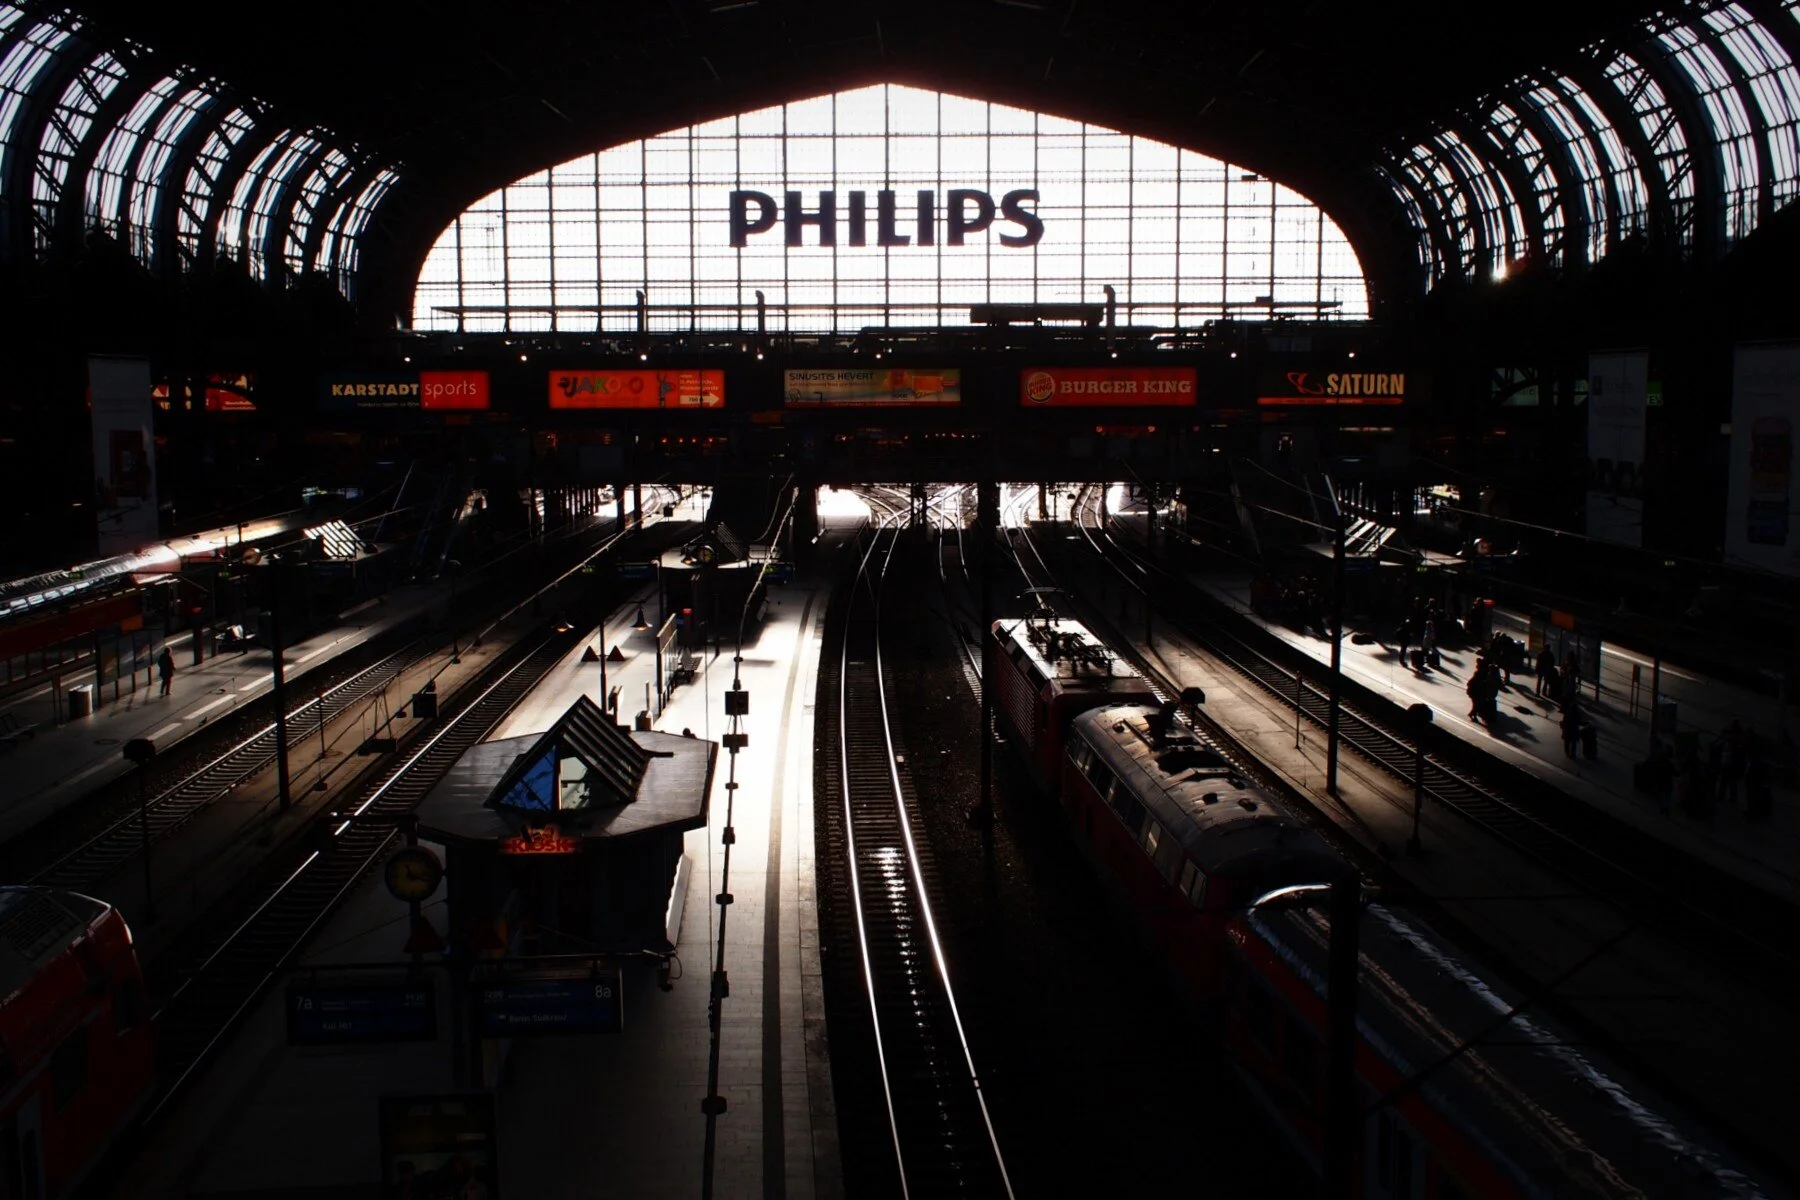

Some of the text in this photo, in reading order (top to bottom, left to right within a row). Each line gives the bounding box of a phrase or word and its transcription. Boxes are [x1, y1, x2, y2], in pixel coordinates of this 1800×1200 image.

[729, 189, 1045, 248] PHILIPS
[789, 372, 874, 381] SINUSITIS HEVERT
[1327, 373, 1405, 395] SATURN
[331, 383, 419, 396] KARSTADT
[424, 381, 478, 400] sports
[1060, 381, 1192, 393] BURGER KING
[595, 984, 612, 999] 8a
[294, 996, 313, 1011] 7a
